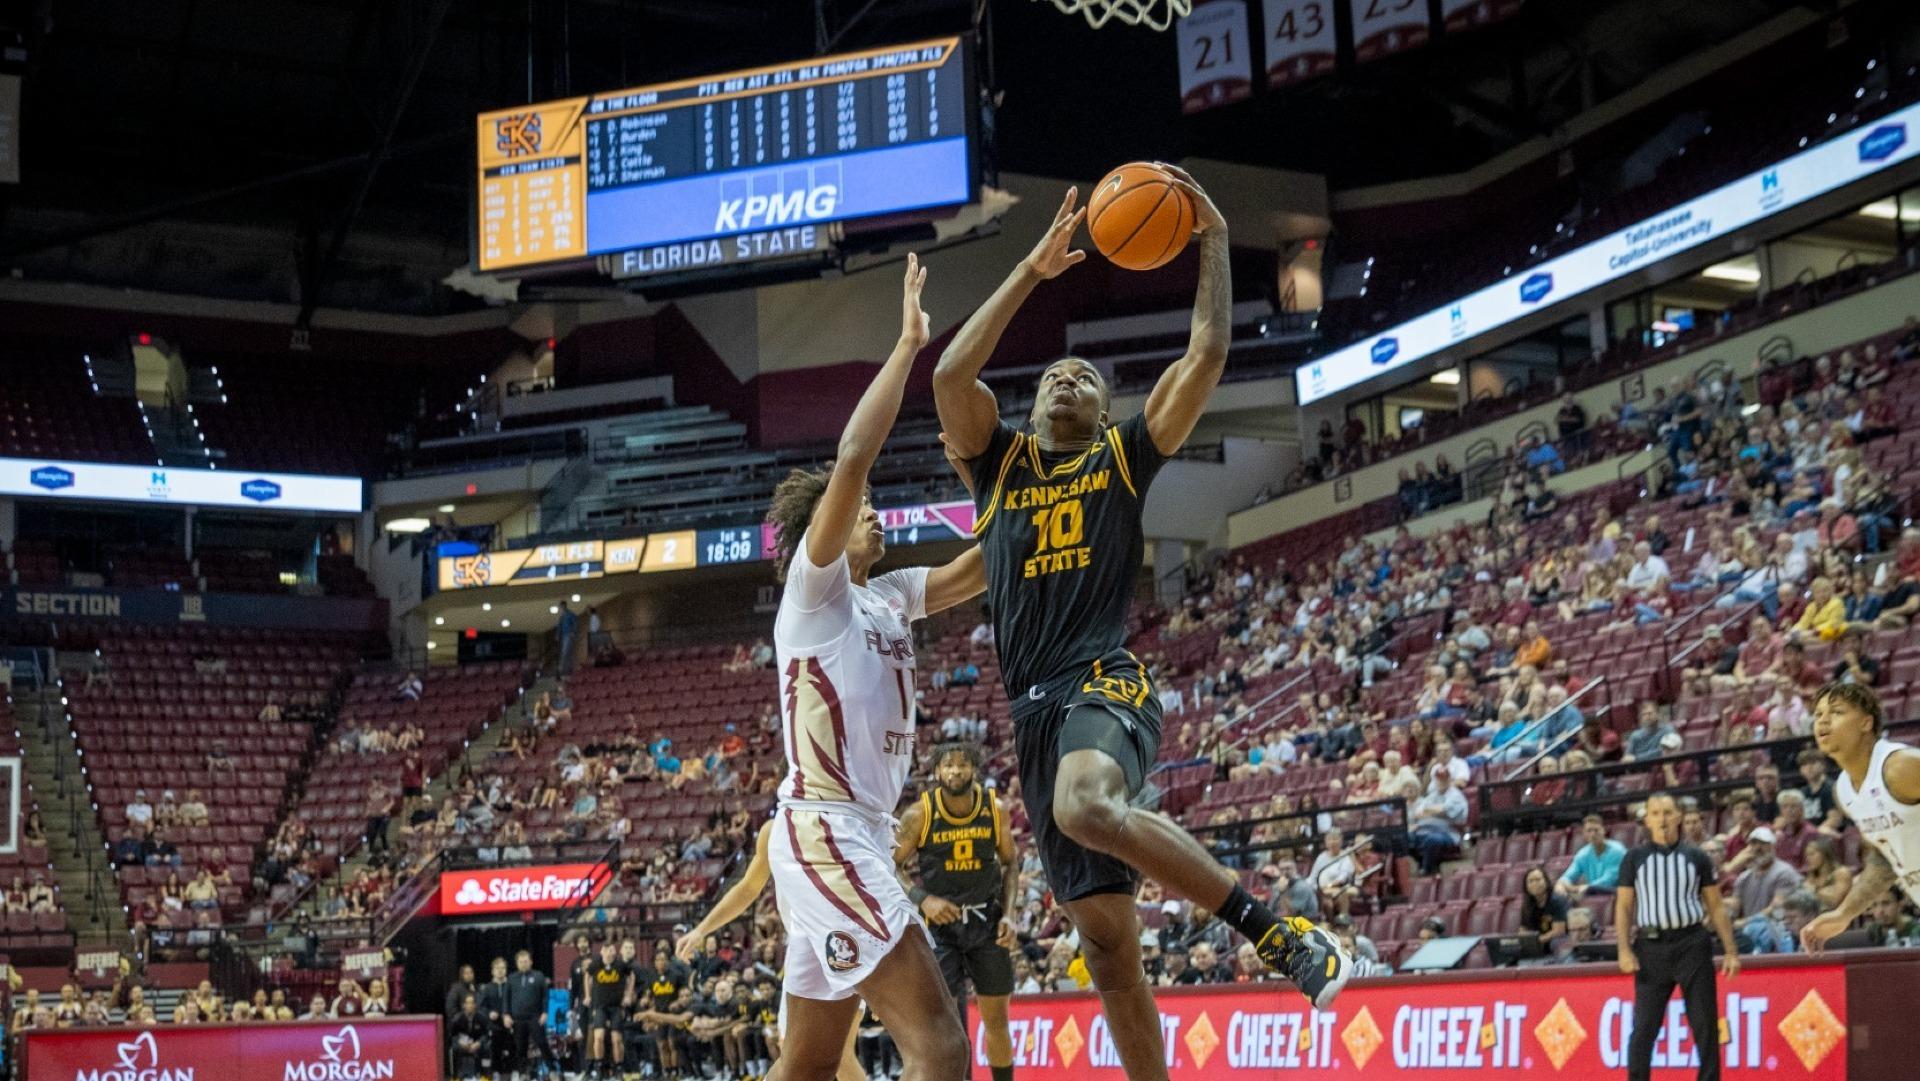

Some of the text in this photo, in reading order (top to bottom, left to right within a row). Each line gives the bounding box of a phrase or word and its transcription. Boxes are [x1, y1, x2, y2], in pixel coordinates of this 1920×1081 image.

[1275, 2, 1324, 43] 43
[1195, 28, 1231, 71] 21
[698, 83, 719, 97] PTS
[747, 74, 769, 89] AST
[755, 96, 762, 110] 0
[781, 92, 788, 105] 0
[806, 88, 814, 101] 0
[704, 118, 712, 130] 0
[730, 113, 738, 126] 0
[755, 110, 763, 122] 0
[781, 106, 789, 119] 0
[806, 102, 814, 115] 0
[705, 131, 713, 143] 0
[730, 127, 738, 139] 0
[755, 123, 763, 136] 0
[781, 119, 789, 132] 0
[807, 115, 815, 128] 0
[705, 144, 713, 156] 0
[731, 139, 739, 152] 0
[782, 132, 790, 145] 0
[807, 128, 815, 141] 0
[705, 157, 713, 171] 0
[756, 149, 764, 162] 0
[782, 145, 790, 158] 0
[807, 142, 816, 155] 0
[714, 184, 838, 233] KPMG
[1625, 210, 1693, 245] Tallahassee
[623, 225, 816, 273] FLORIDA STATE
[904, 506, 928, 526] TOL
[1032, 499, 1083, 556] 10
[720, 531, 735, 543] 1st
[908, 527, 918, 544] 4
[540, 542, 594, 561] TOL FLS
[609, 539, 677, 564] KEN 2
[707, 541, 751, 563] 18:09
[1024, 547, 1091, 578] STATE
[547, 562, 589, 580] 4 2
[16, 593, 120, 616] SECTION
[932, 826, 992, 844] KENNESAW
[954, 840, 973, 860] 0
[944, 858, 982, 872] STATE
[75, 1067, 194, 1081] MORGAN
[284, 1059, 394, 1081] MORGAN
